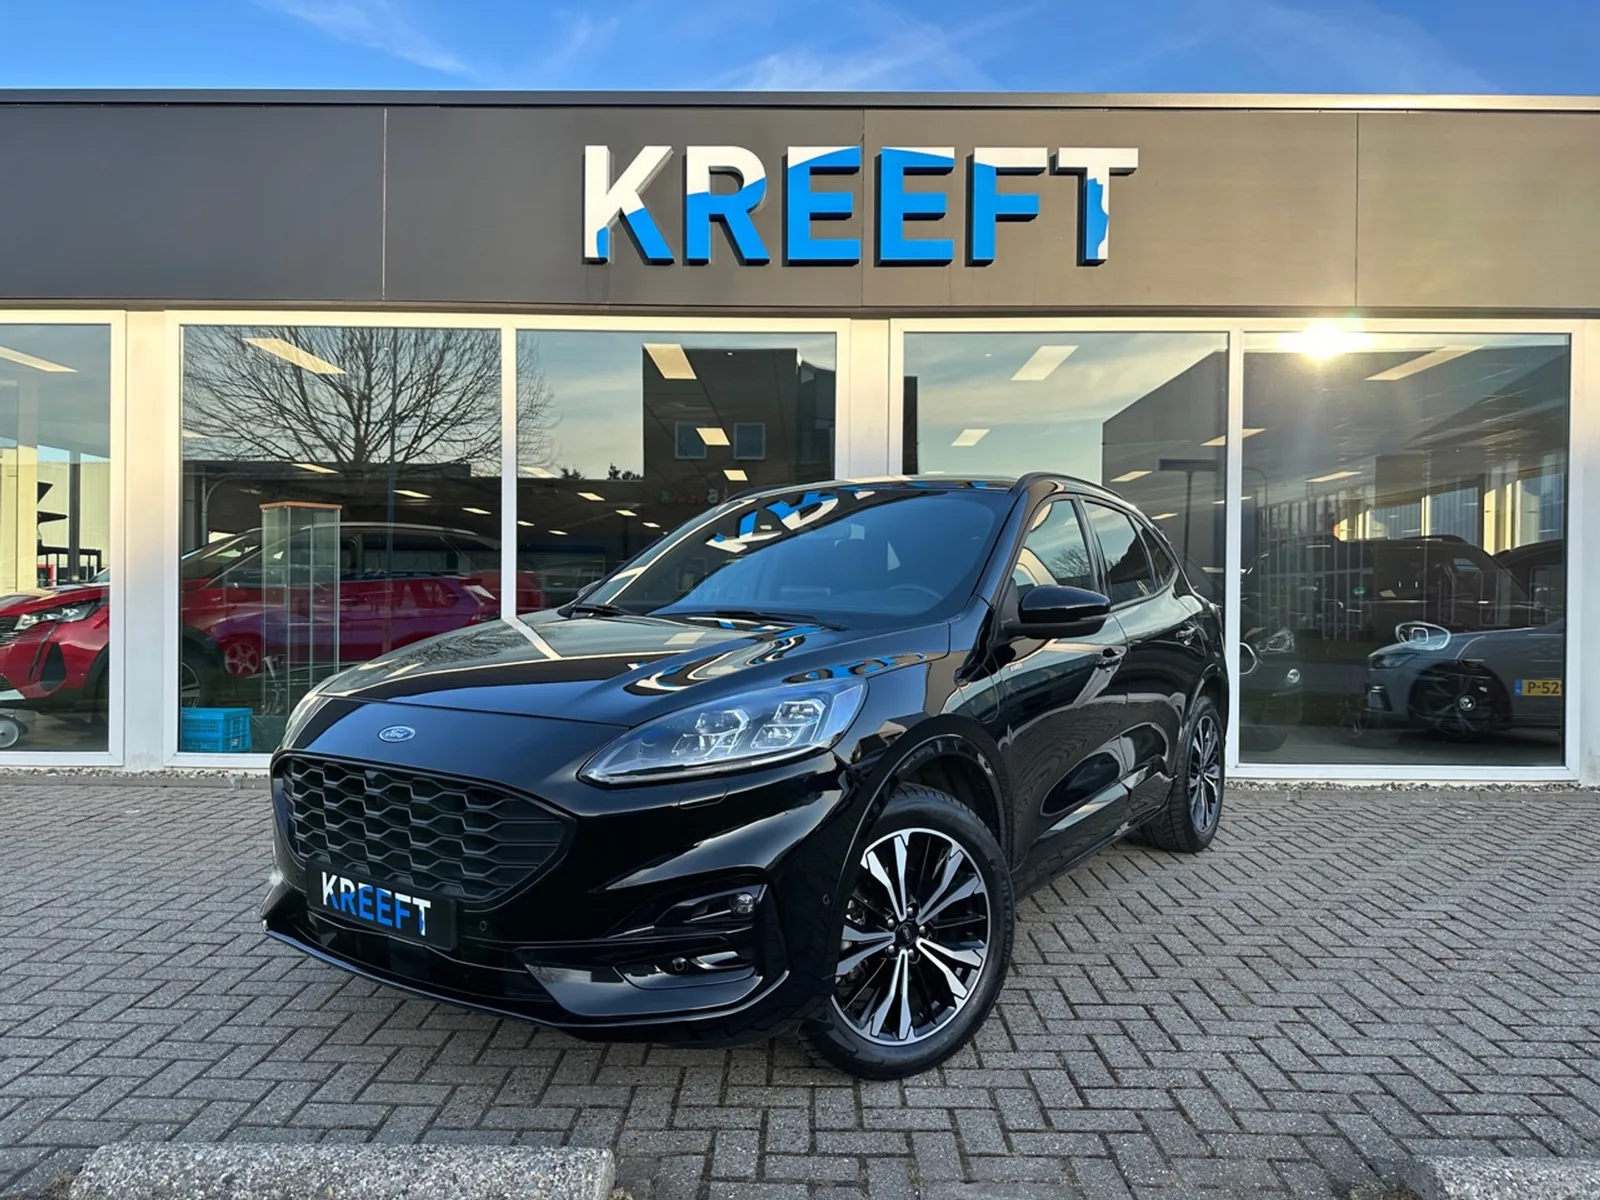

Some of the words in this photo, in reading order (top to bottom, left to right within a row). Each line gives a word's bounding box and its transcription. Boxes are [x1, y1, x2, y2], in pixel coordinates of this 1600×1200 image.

[583, 145, 1139, 263] KREEFT
[1528, 681, 1562, 694] P-52
[321, 871, 431, 936] KREEFT
